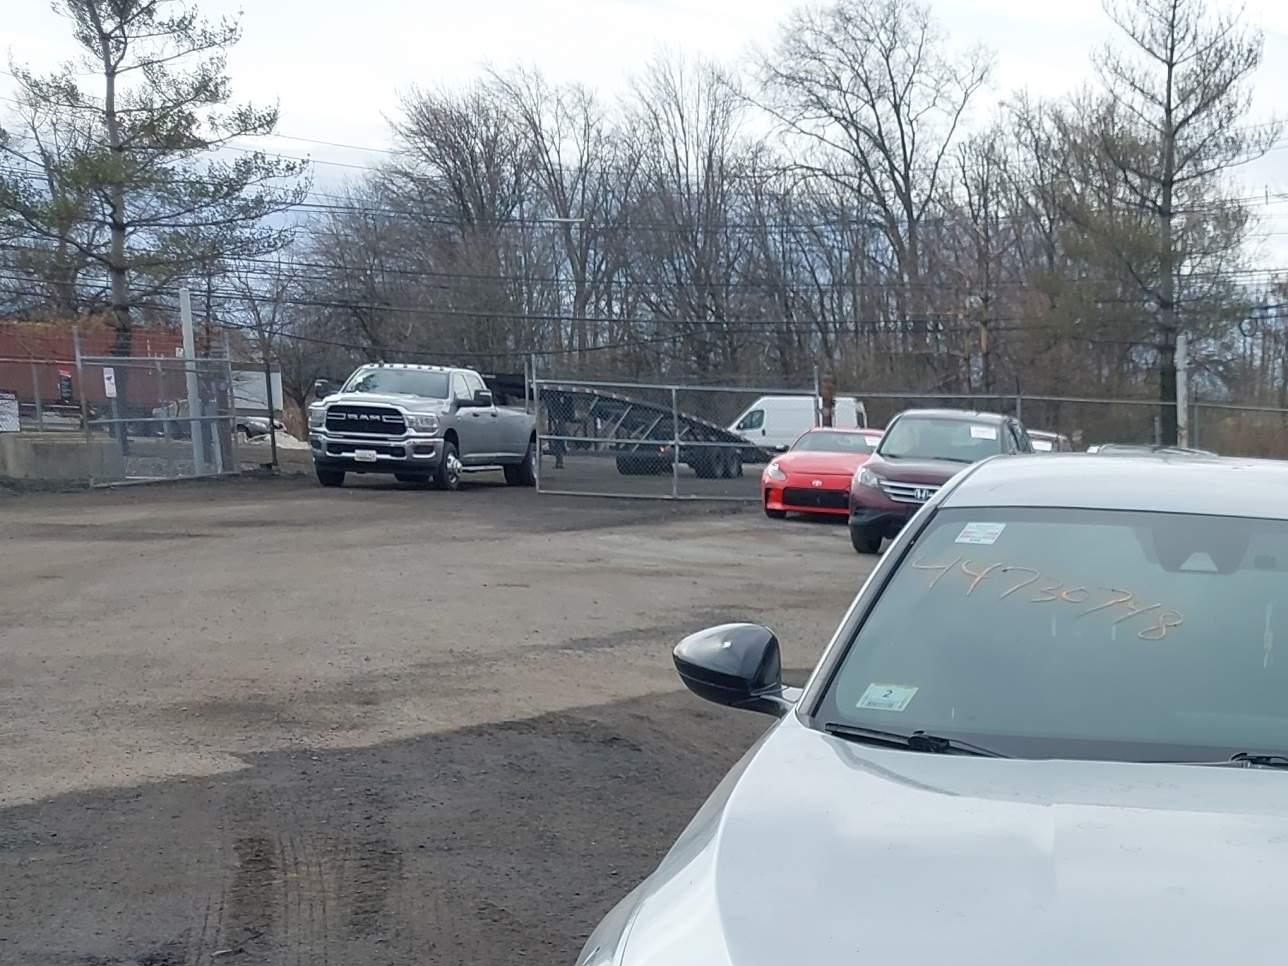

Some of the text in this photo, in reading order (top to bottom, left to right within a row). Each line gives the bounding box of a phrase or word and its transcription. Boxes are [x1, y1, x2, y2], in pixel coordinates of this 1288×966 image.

[347, 413, 380, 421] RAM
[911, 555, 1185, 641] 44730748
[881, 689, 893, 698] 2
